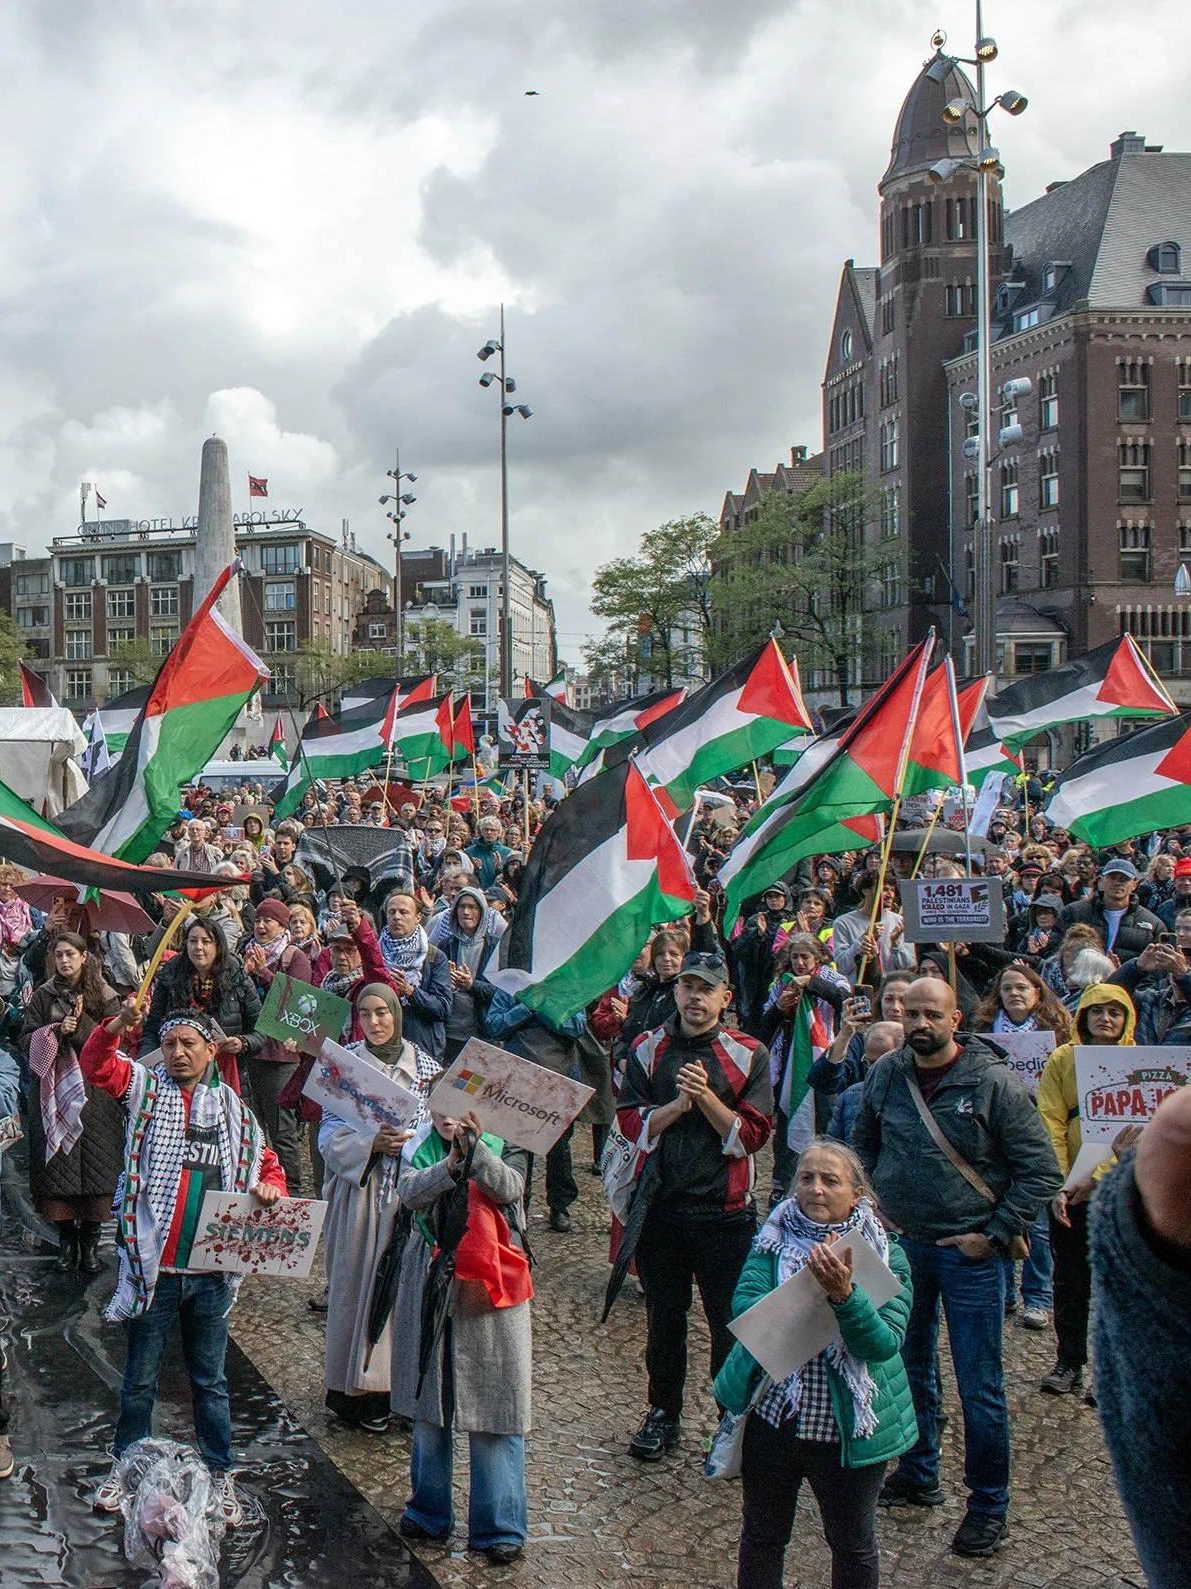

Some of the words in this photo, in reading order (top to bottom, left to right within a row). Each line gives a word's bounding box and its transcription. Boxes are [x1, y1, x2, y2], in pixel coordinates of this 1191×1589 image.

[77, 520, 125, 537] GRAND
[130, 518, 175, 532] HOTEL
[924, 884, 962, 898] 1,481
[956, 915, 987, 923] TERRORIST?
[280, 1008, 321, 1038] XBOX
[1140, 1071, 1173, 1082] PIZZA
[482, 1083, 562, 1126] Microsoft
[1091, 1088, 1147, 1117] PAPA
[205, 1222, 311, 1247] SIEMENS
